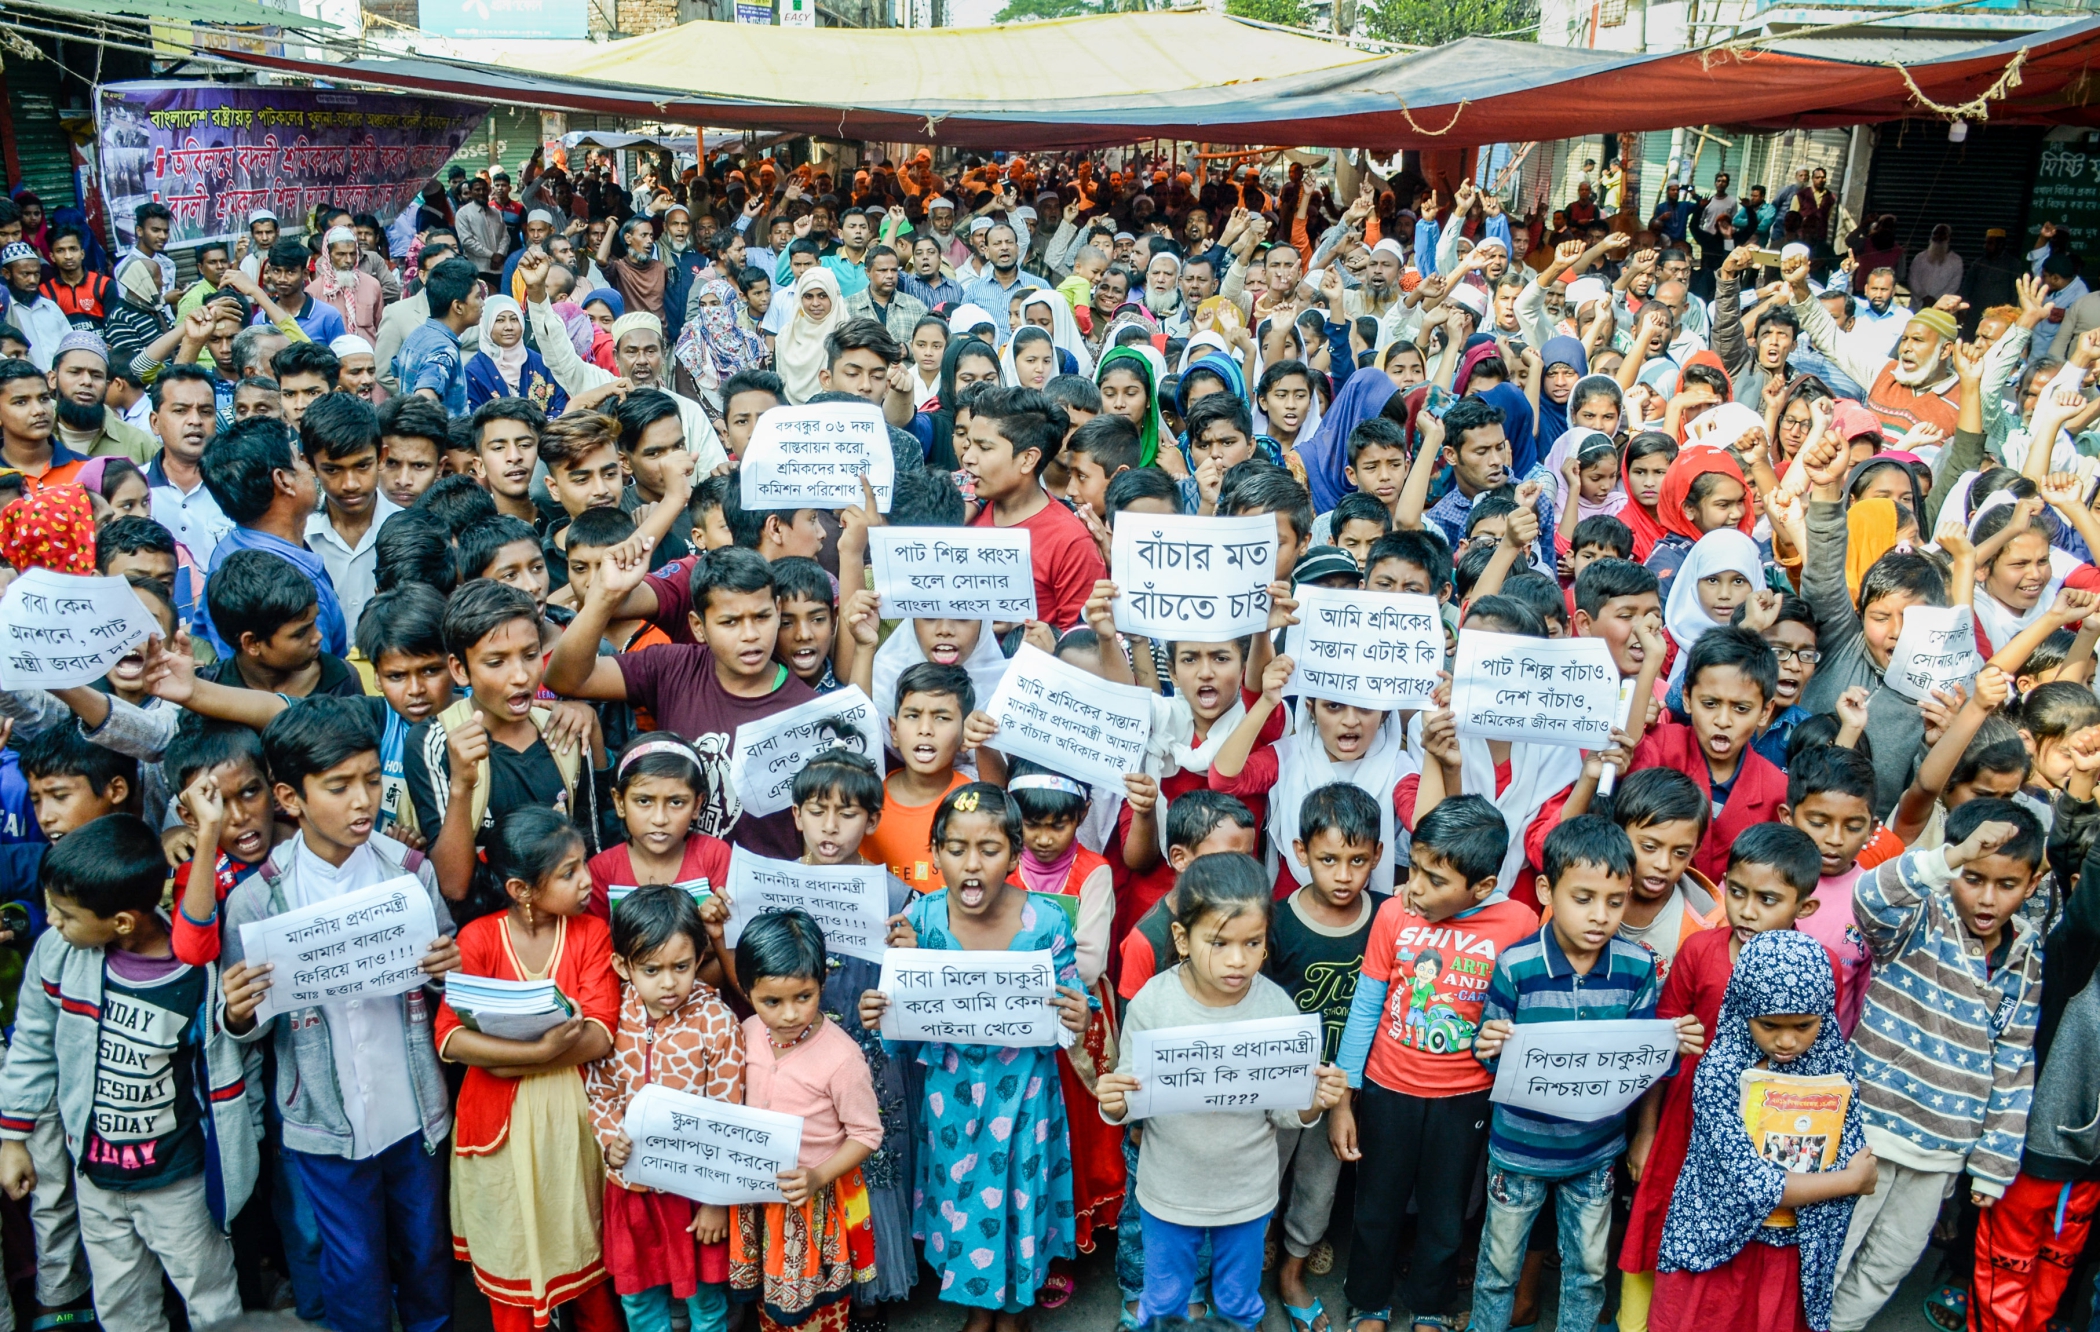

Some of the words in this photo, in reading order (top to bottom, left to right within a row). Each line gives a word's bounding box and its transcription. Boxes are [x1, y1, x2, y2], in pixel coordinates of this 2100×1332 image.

[784, 13, 811, 22] EASY
[149, 109, 209, 130] বাংলাদেশ
[257, 107, 304, 127] পাটকলের
[307, 110, 363, 130] খুলনা-যশোর
[236, 133, 281, 180] বদলী
[281, 135, 347, 178] শ্রমিকদের
[2039, 151, 2086, 178] মিষ্টি
[167, 183, 210, 230] বদলী
[775, 420, 820, 436] বঙ্গবন্ধুর
[825, 422, 845, 433] ০৬
[850, 421, 875, 433] দফা
[779, 441, 830, 454] বাস্তবায়ন
[777, 459, 835, 475] শ্রমিকদের
[839, 459, 872, 477] মজুরী
[757, 480, 801, 495] কমিশন
[806, 481, 856, 496] পরিশোধ
[895, 541, 927, 563] পাট
[933, 541, 969, 564] শিল্প
[977, 547, 1019, 565] ধ্বংস
[1135, 530, 1214, 571] বাঁচার
[1222, 541, 1271, 570] মত
[908, 575, 945, 590] হলে
[952, 574, 1009, 589] সোনার
[22, 591, 49, 615] বাবা
[55, 599, 96, 615] কেন
[894, 599, 942, 613] বাংলা
[949, 599, 990, 613] ধ্বংস
[996, 598, 1031, 611] হবে
[1128, 581, 1219, 621] বাঁচতে
[1227, 581, 1268, 619] চাই
[90, 618, 127, 638] পাট
[1320, 604, 1362, 628] আমি
[1367, 606, 1432, 631] শ্রমিকের
[1929, 623, 1969, 644] সোনালী
[9, 651, 43, 673] মন্ত্রী
[47, 653, 104, 672] জবাব
[107, 629, 142, 655] দাও
[1309, 639, 1357, 661] সন্তান
[1363, 638, 1410, 664] এটাই
[1415, 640, 1436, 664] কি
[1913, 653, 1953, 668] সোনার
[1481, 656, 1514, 676] পাট
[1520, 657, 1555, 681] শিল্প
[1303, 669, 1360, 691] আমার
[1366, 676, 1434, 695] অপরাধ?
[1906, 672, 1934, 690] মন্ত্রী
[1017, 675, 1045, 699] আমি
[1047, 690, 1102, 721] শ্রমিকের
[1496, 689, 1531, 706] দেশ
[1008, 697, 1048, 722] মাননীয়
[1050, 715, 1102, 742] প্রধানমন্ত্রী
[1106, 733, 1142, 754] আমার
[1471, 710, 1526, 728] শ্রমিকের
[1531, 713, 1567, 731] জীবন
[1572, 716, 1609, 732] বাঁচাও
[743, 736, 779, 758] বাবা
[1000, 714, 1017, 730] কি
[1020, 722, 1052, 744] বাঁচার
[1055, 735, 1100, 761] অধিকার
[752, 870, 800, 888] মাননীয়
[805, 877, 867, 895] প্রধানমন্ত্রী
[761, 892, 804, 906] আমার
[811, 897, 859, 912] বাবাকে
[285, 917, 341, 944] মাননীয়
[345, 892, 409, 927] প্রধানমন্ত্রী
[298, 940, 347, 963] আমার
[352, 924, 406, 948] বাবাকে
[823, 930, 868, 946] পরিবার
[1395, 926, 1496, 961] SHIVA
[293, 962, 350, 986] ফিরিয়ে
[369, 965, 420, 988] পরিবার
[895, 969, 934, 988] বাবা
[941, 966, 987, 987] মিলে
[993, 965, 1052, 991] চাকুরী
[1442, 973, 1489, 990] AND
[903, 999, 945, 1014] করে
[951, 992, 997, 1012] আমি
[1005, 996, 1045, 1011] কেন
[1388, 984, 1406, 1041] RESCUE
[921, 1020, 976, 1037] পাইনা
[984, 1021, 1034, 1037] খেতে
[1154, 1040, 1226, 1064] মাননীয়
[1232, 1030, 1317, 1058] প্রধানমন্ত্রী
[1524, 1048, 1590, 1069] পিতার
[1597, 1045, 1671, 1071] চাকুরীর
[1158, 1068, 1207, 1088] আমি
[1213, 1065, 1240, 1084] কি
[1247, 1064, 1310, 1081] রাসেল
[1527, 1076, 1612, 1096] নিশ্চয়তা
[1618, 1074, 1653, 1094] চাই
[1204, 1093, 1260, 1106] না???
[670, 1111, 701, 1134] স্কুল
[706, 1119, 772, 1147] কলেজে
[645, 1136, 721, 1160] লেখাপড়া
[727, 1149, 782, 1174] করবো
[642, 1156, 688, 1174] সোনার
[693, 1164, 731, 1184] বাংলা
[736, 1176, 780, 1192] গড়বো
[56, 1313, 74, 1322] AIR
